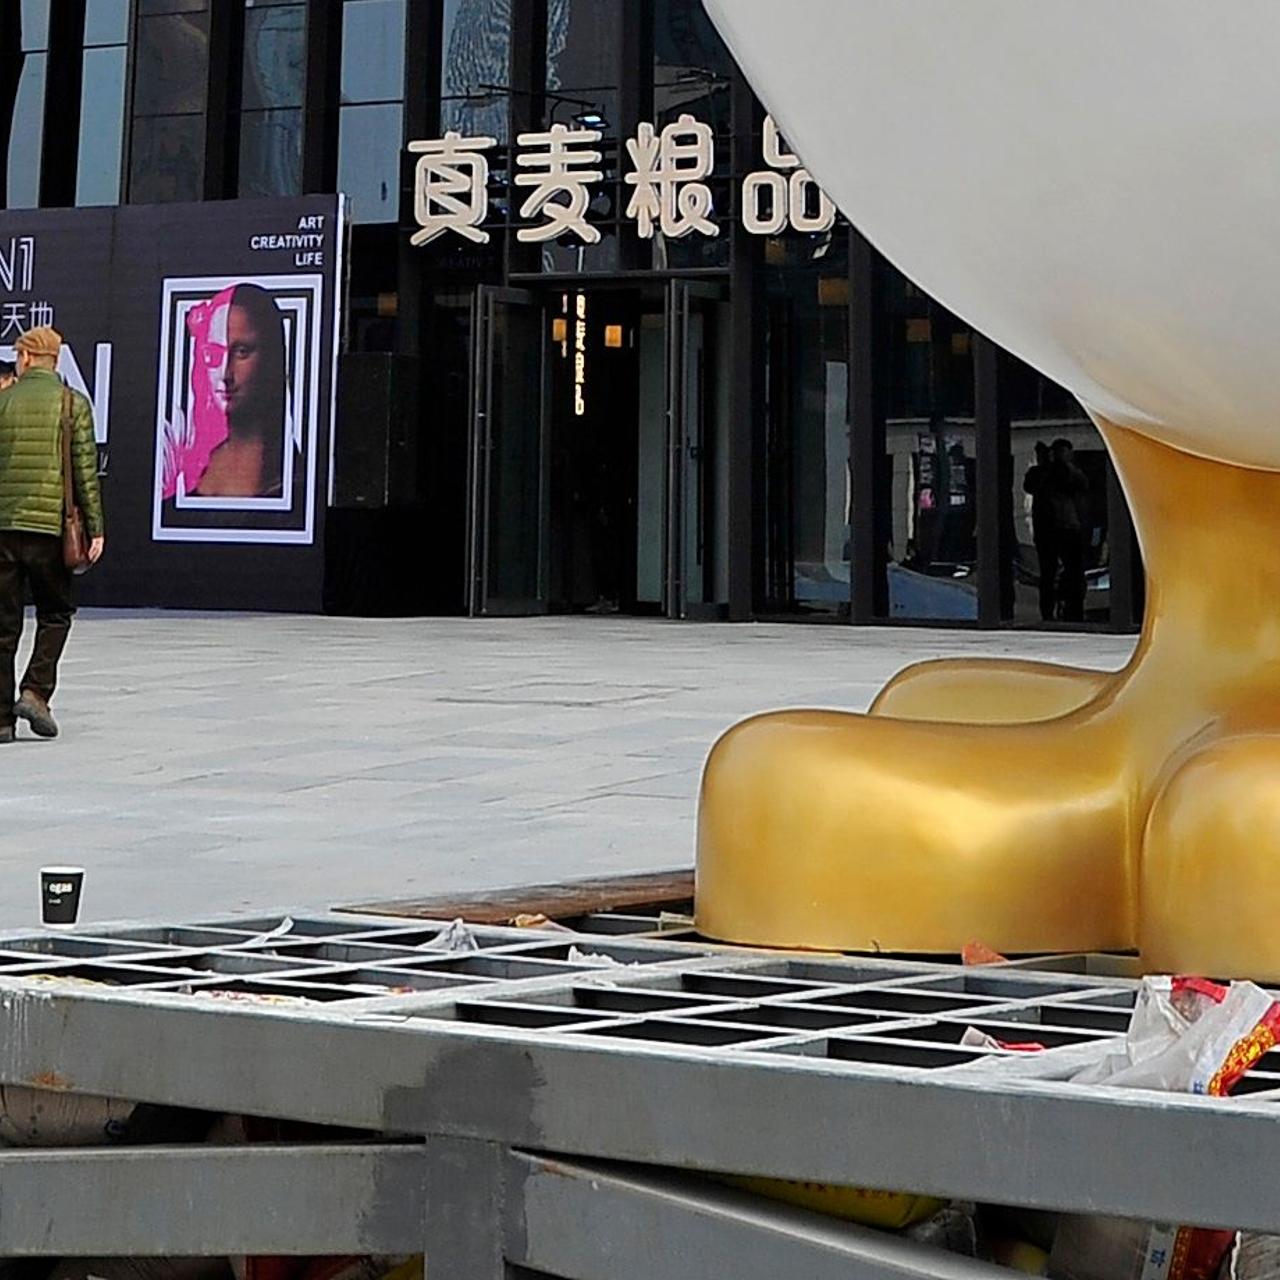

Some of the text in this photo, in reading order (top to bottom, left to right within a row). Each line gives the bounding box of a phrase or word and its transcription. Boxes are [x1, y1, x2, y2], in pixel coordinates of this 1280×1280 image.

[298, 216, 324, 229] ART
[250, 234, 324, 250] CREATIVITY
[295, 252, 323, 266] LIFE
